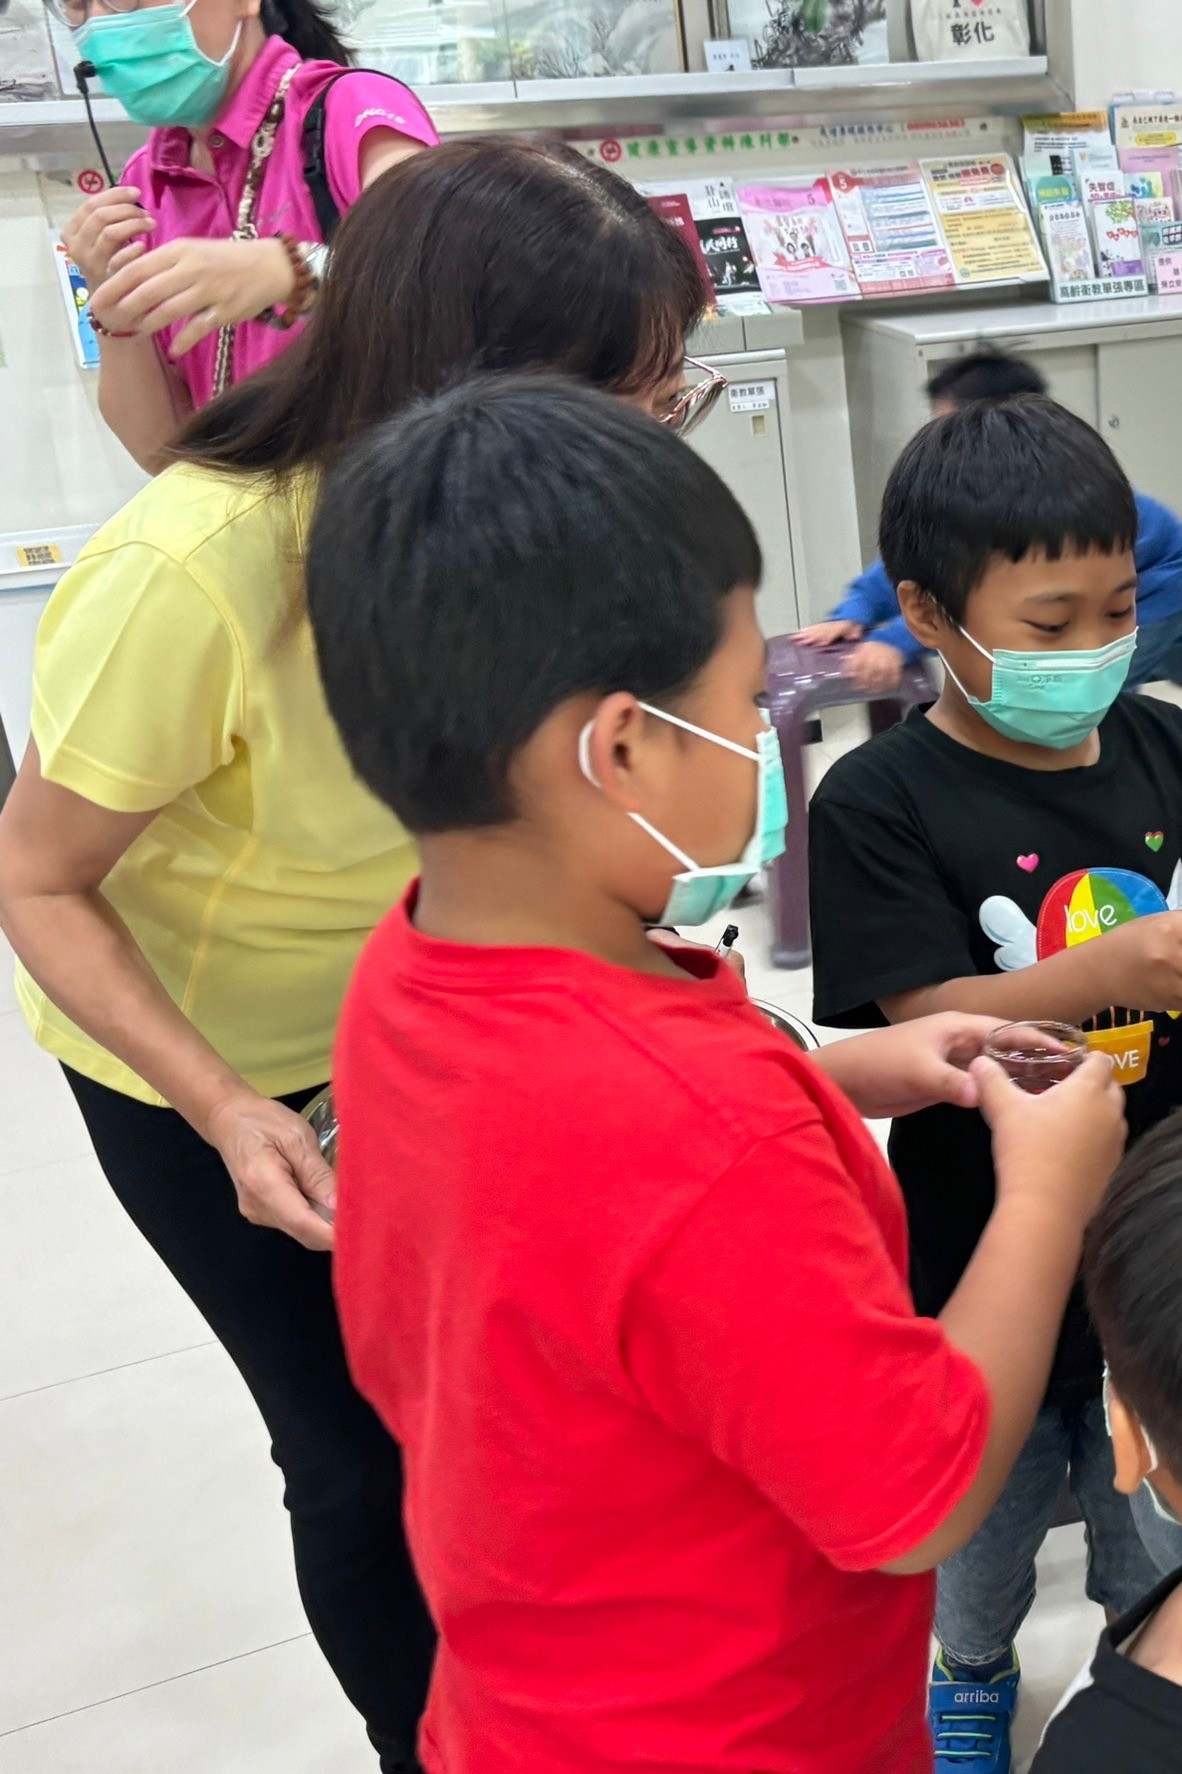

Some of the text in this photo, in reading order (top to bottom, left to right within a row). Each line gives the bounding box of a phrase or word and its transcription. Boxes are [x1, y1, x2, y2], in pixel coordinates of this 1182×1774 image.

[950, 21, 995, 46] 彰化
[1063, 904, 1118, 933] love
[954, 1690, 1000, 1703] arriba
